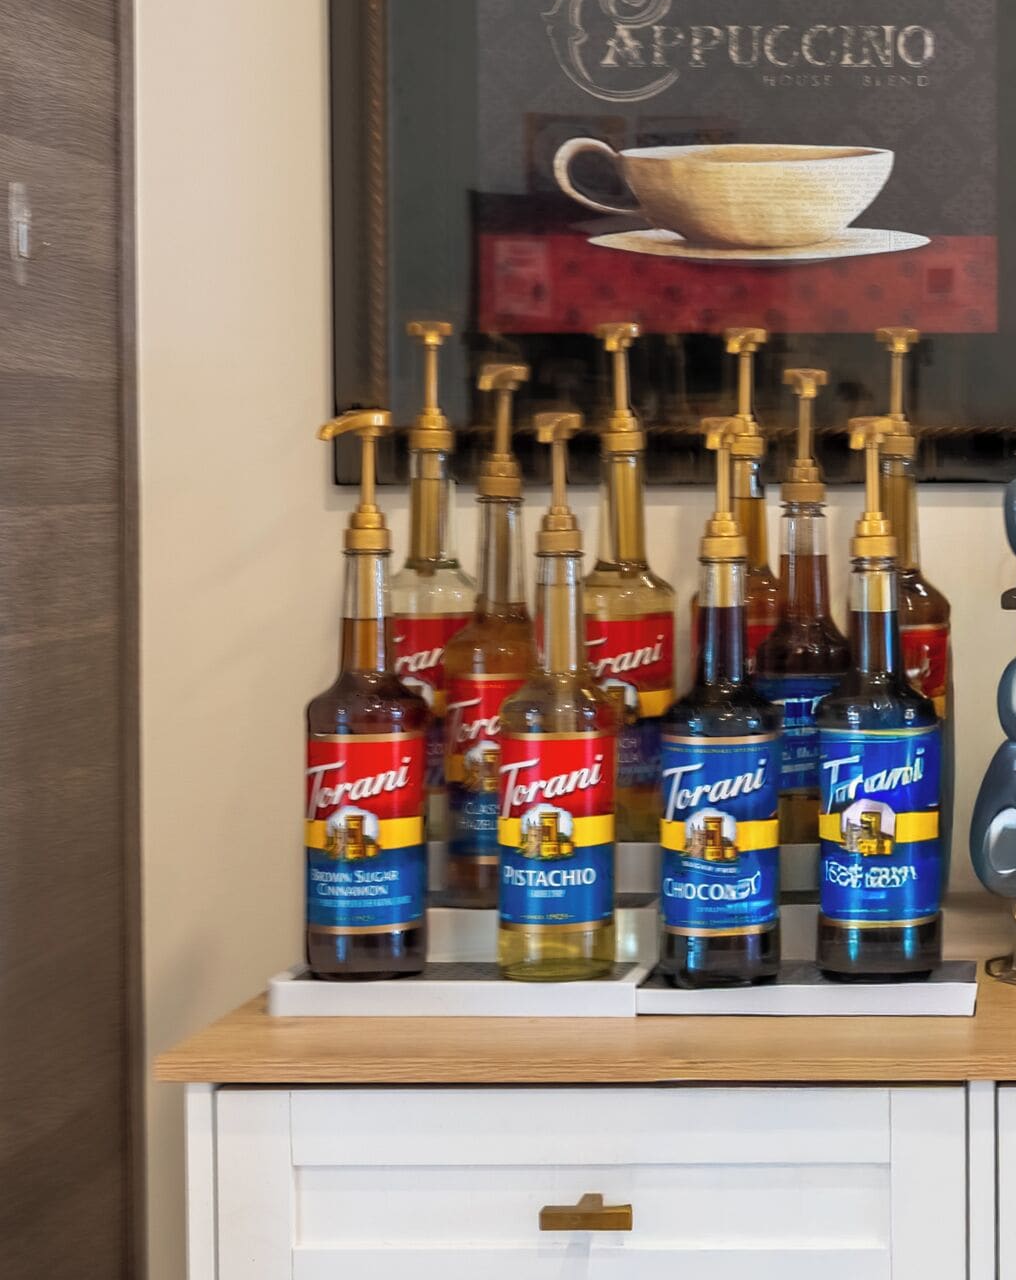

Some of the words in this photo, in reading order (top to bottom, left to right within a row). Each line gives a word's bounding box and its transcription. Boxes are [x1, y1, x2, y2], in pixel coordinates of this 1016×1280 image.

[762, 74, 834, 88] HOUSE
[861, 74, 930, 88] BLEND
[304, 756, 412, 822] Torani
[499, 754, 604, 820] Torani
[662, 758, 767, 823] Torani
[503, 865, 597, 887] PISTACHIO
